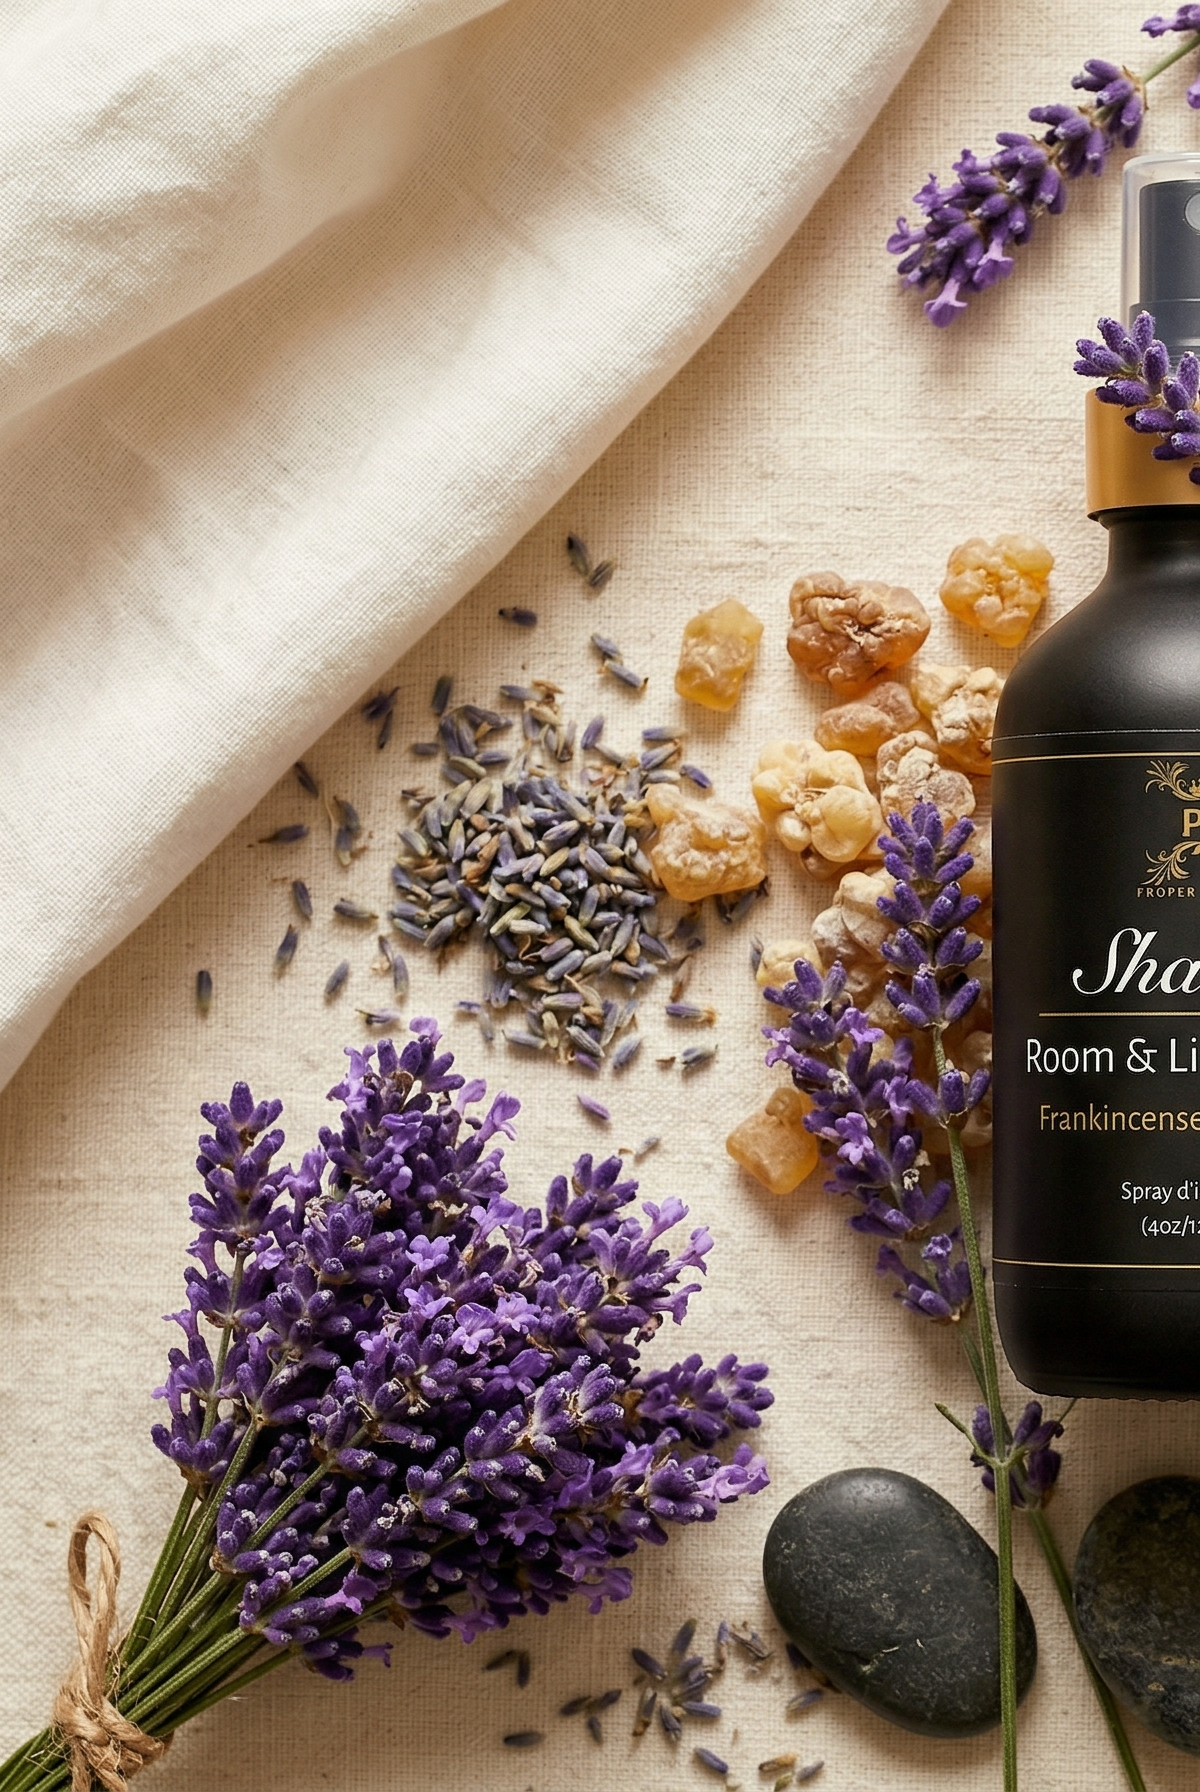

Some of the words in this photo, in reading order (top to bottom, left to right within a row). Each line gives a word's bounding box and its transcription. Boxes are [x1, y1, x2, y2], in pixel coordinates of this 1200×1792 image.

[1026, 1038, 1113, 1073] Room
[1127, 1038, 1157, 1073] &
[1121, 1181, 1173, 1205] Spray
